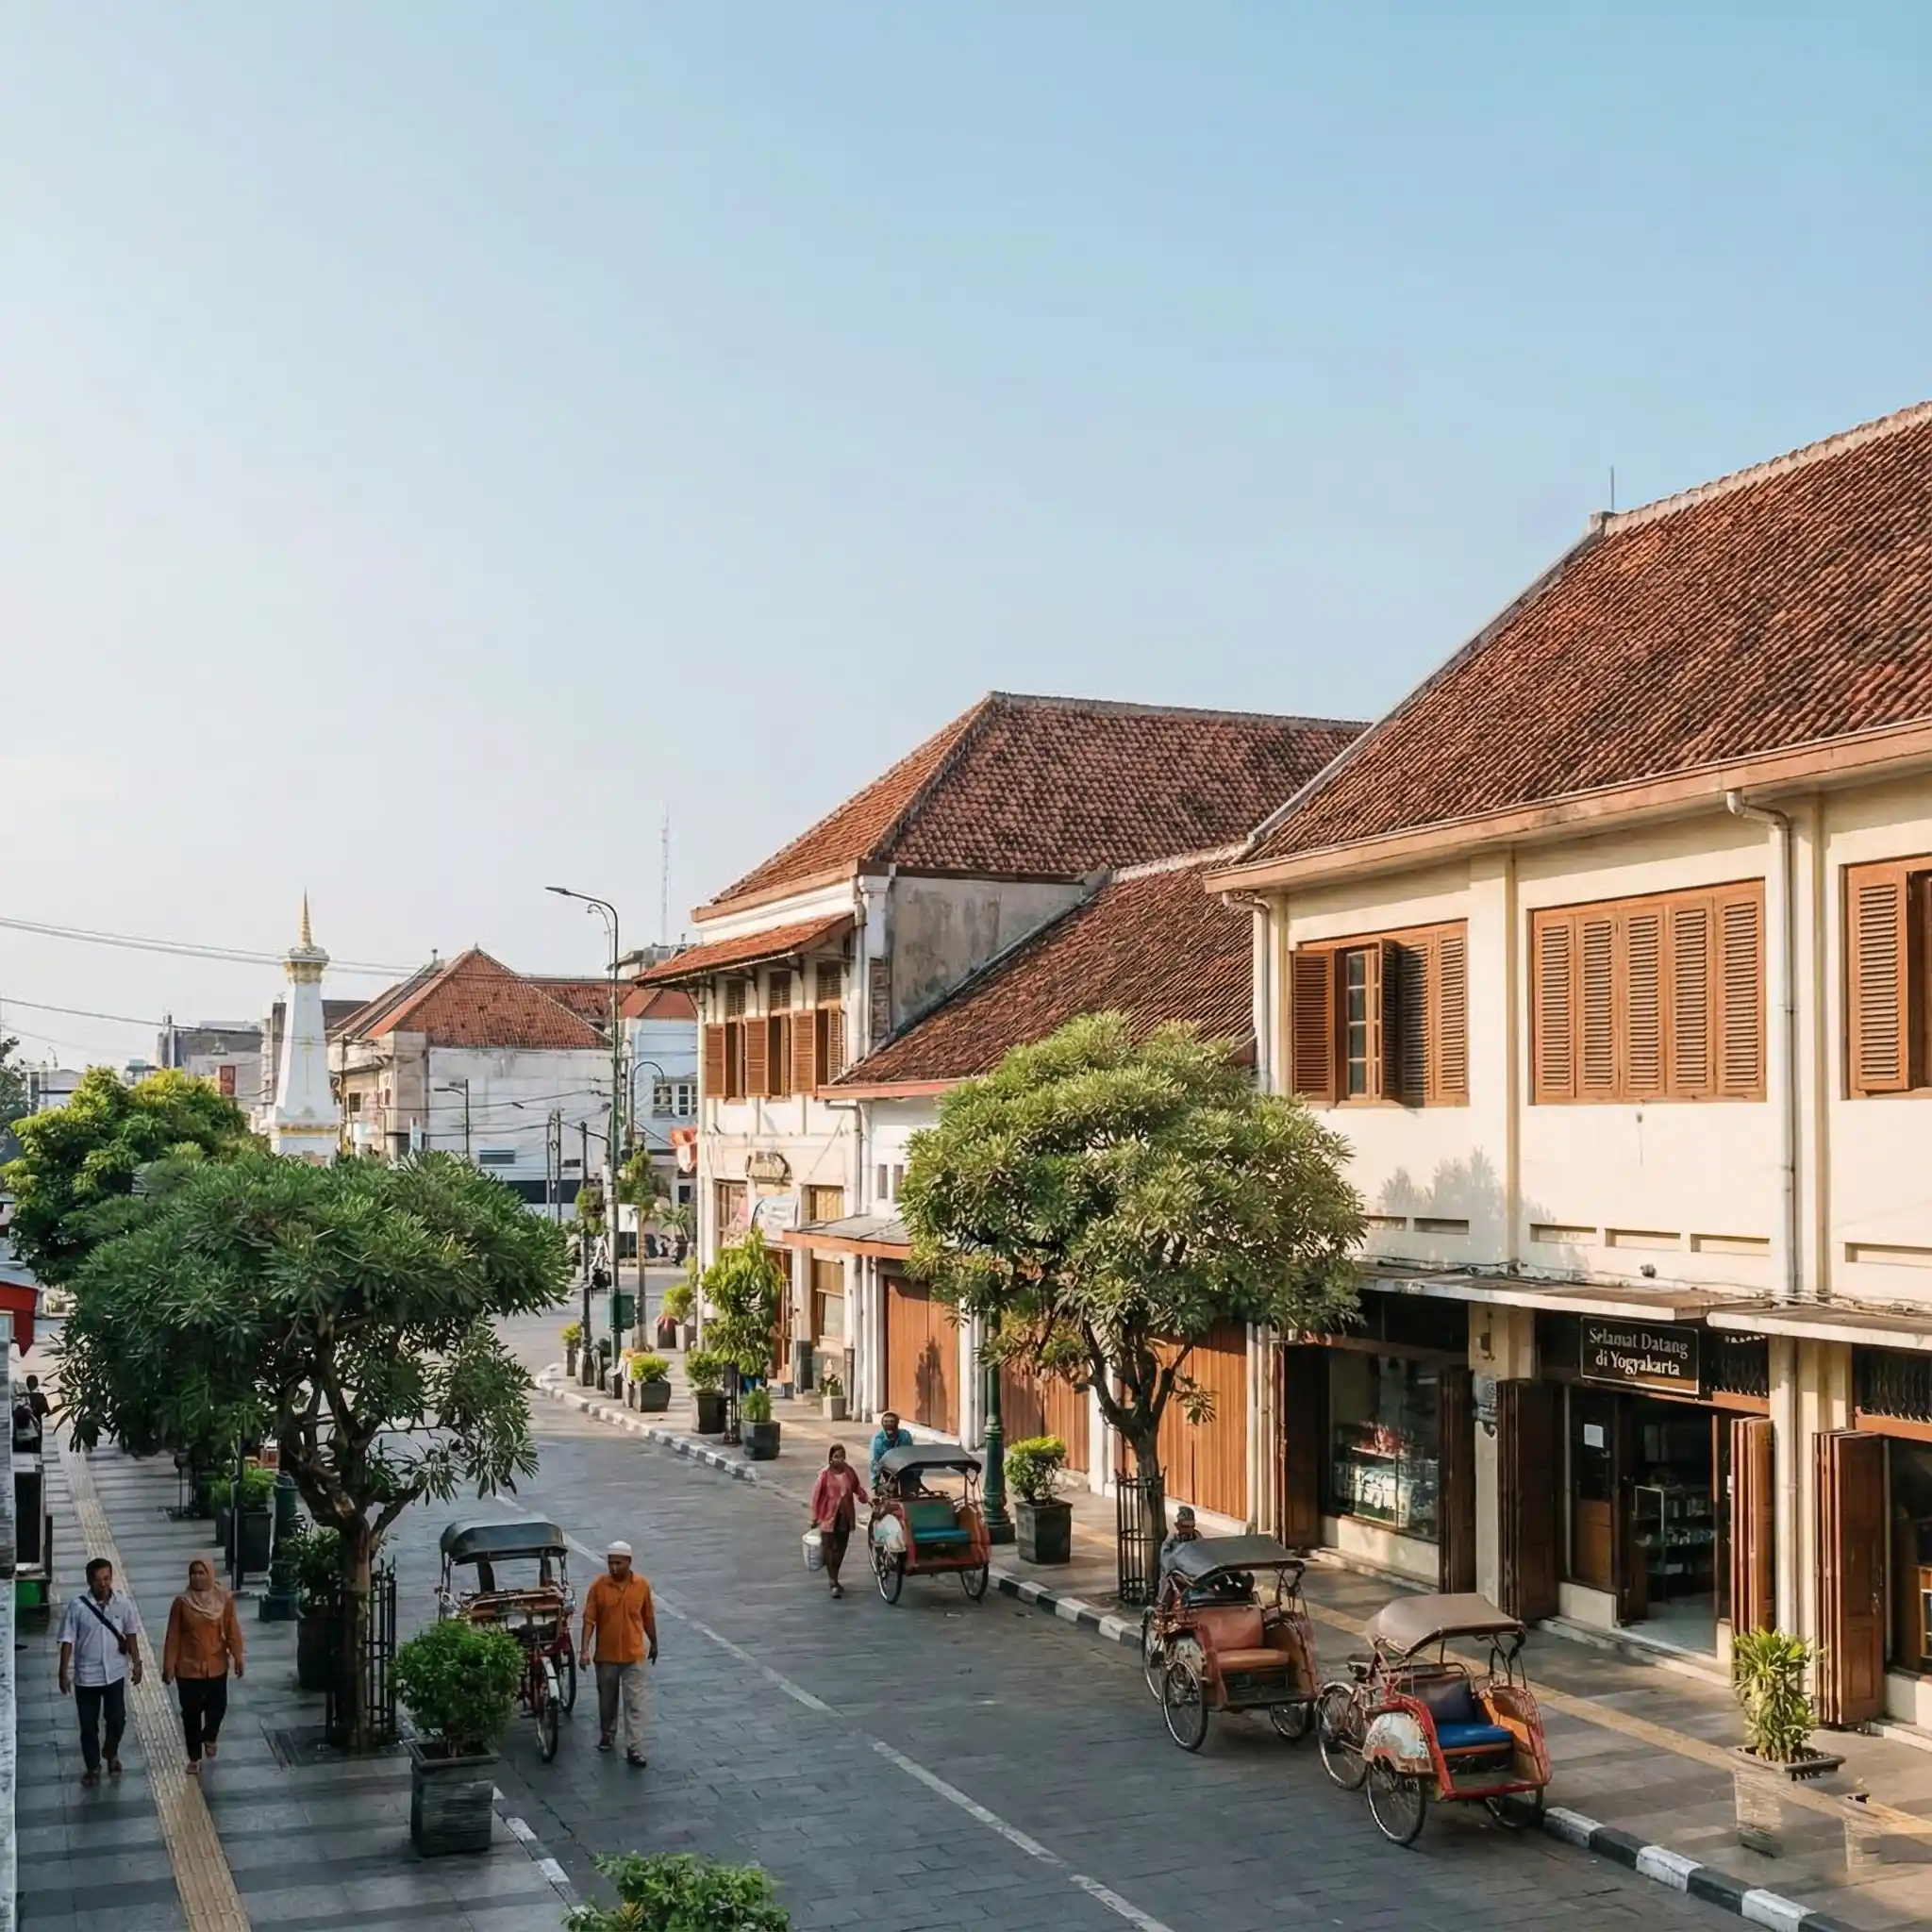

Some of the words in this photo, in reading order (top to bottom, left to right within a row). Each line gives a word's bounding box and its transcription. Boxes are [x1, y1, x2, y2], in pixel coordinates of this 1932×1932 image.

[1589, 1328, 1638, 1348] Selamat
[1641, 1333, 1689, 1359] Datang
[1595, 1349, 1608, 1367] di
[1610, 1350, 1680, 1376] Yogyakarta
